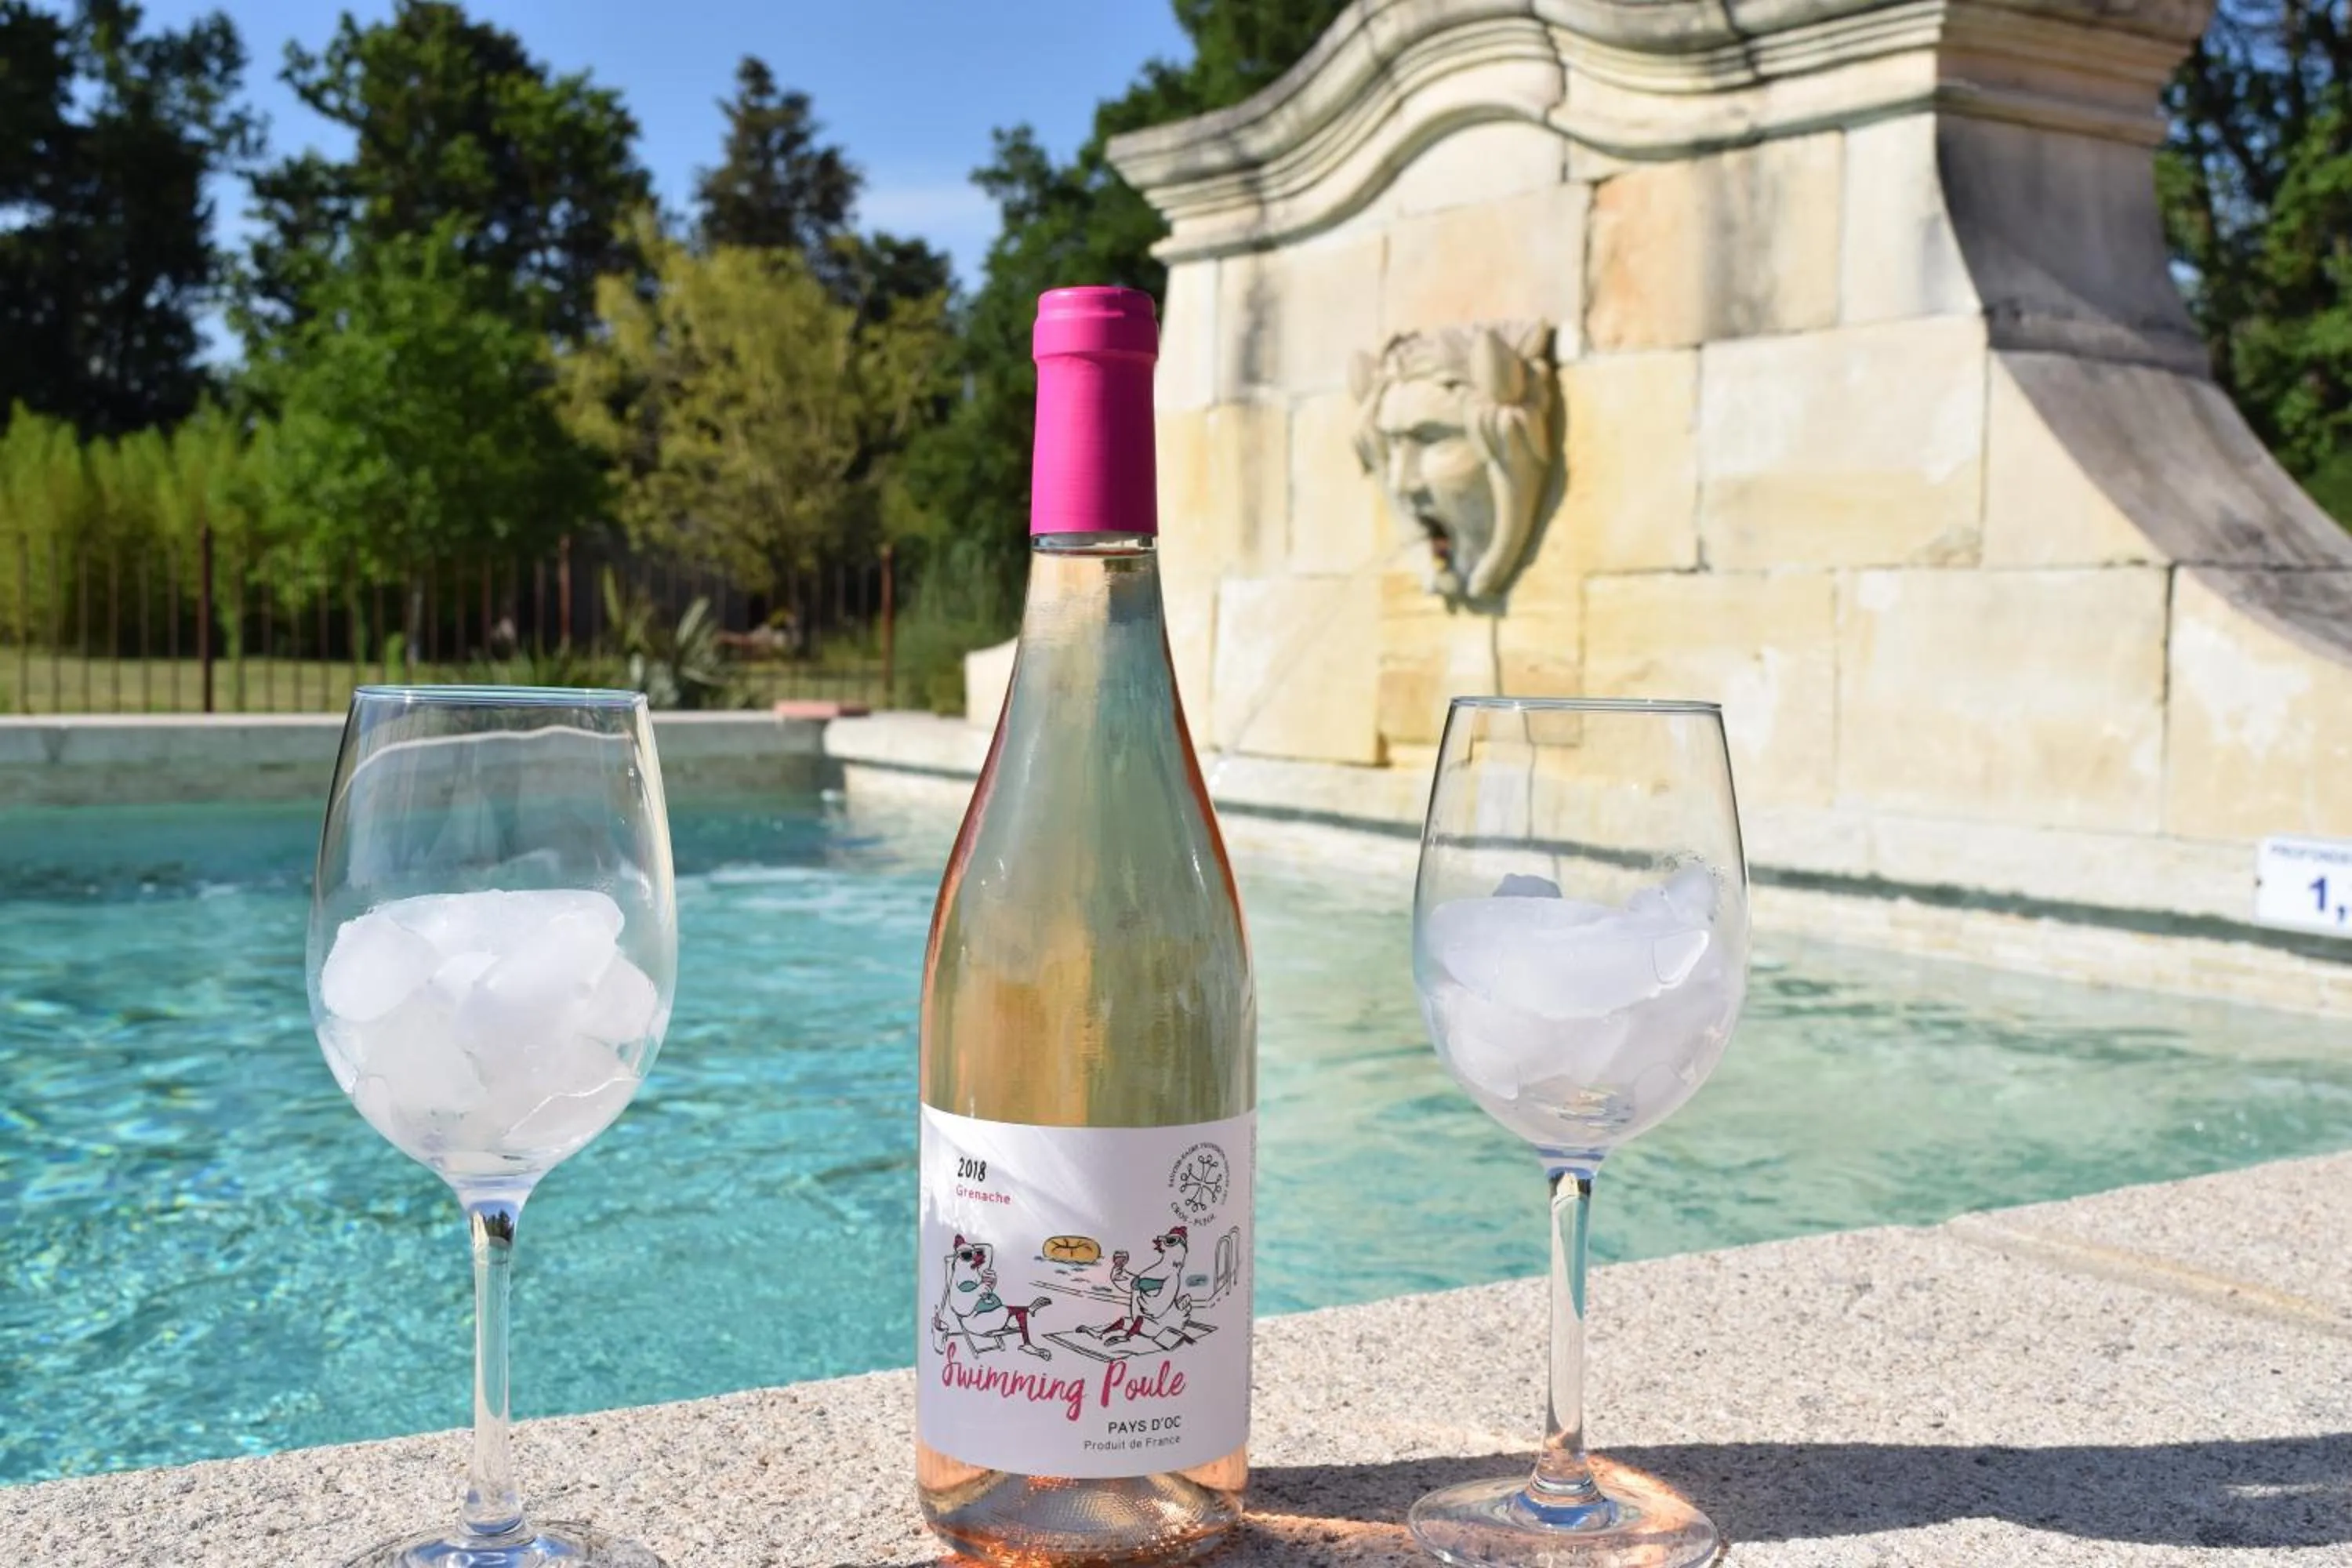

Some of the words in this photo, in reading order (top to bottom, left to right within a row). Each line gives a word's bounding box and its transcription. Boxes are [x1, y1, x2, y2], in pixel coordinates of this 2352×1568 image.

[957, 1156, 987, 1182] 2018
[956, 1184, 1011, 1205] Grenache
[942, 1341, 1085, 1421] Swimming
[1100, 1359, 1186, 1408] Poule
[1108, 1420, 1147, 1434] PAYS
[1152, 1415, 1181, 1431] D'OC
[1084, 1439, 1126, 1450] Produit
[1129, 1439, 1142, 1450] de
[1145, 1436, 1181, 1447] France
